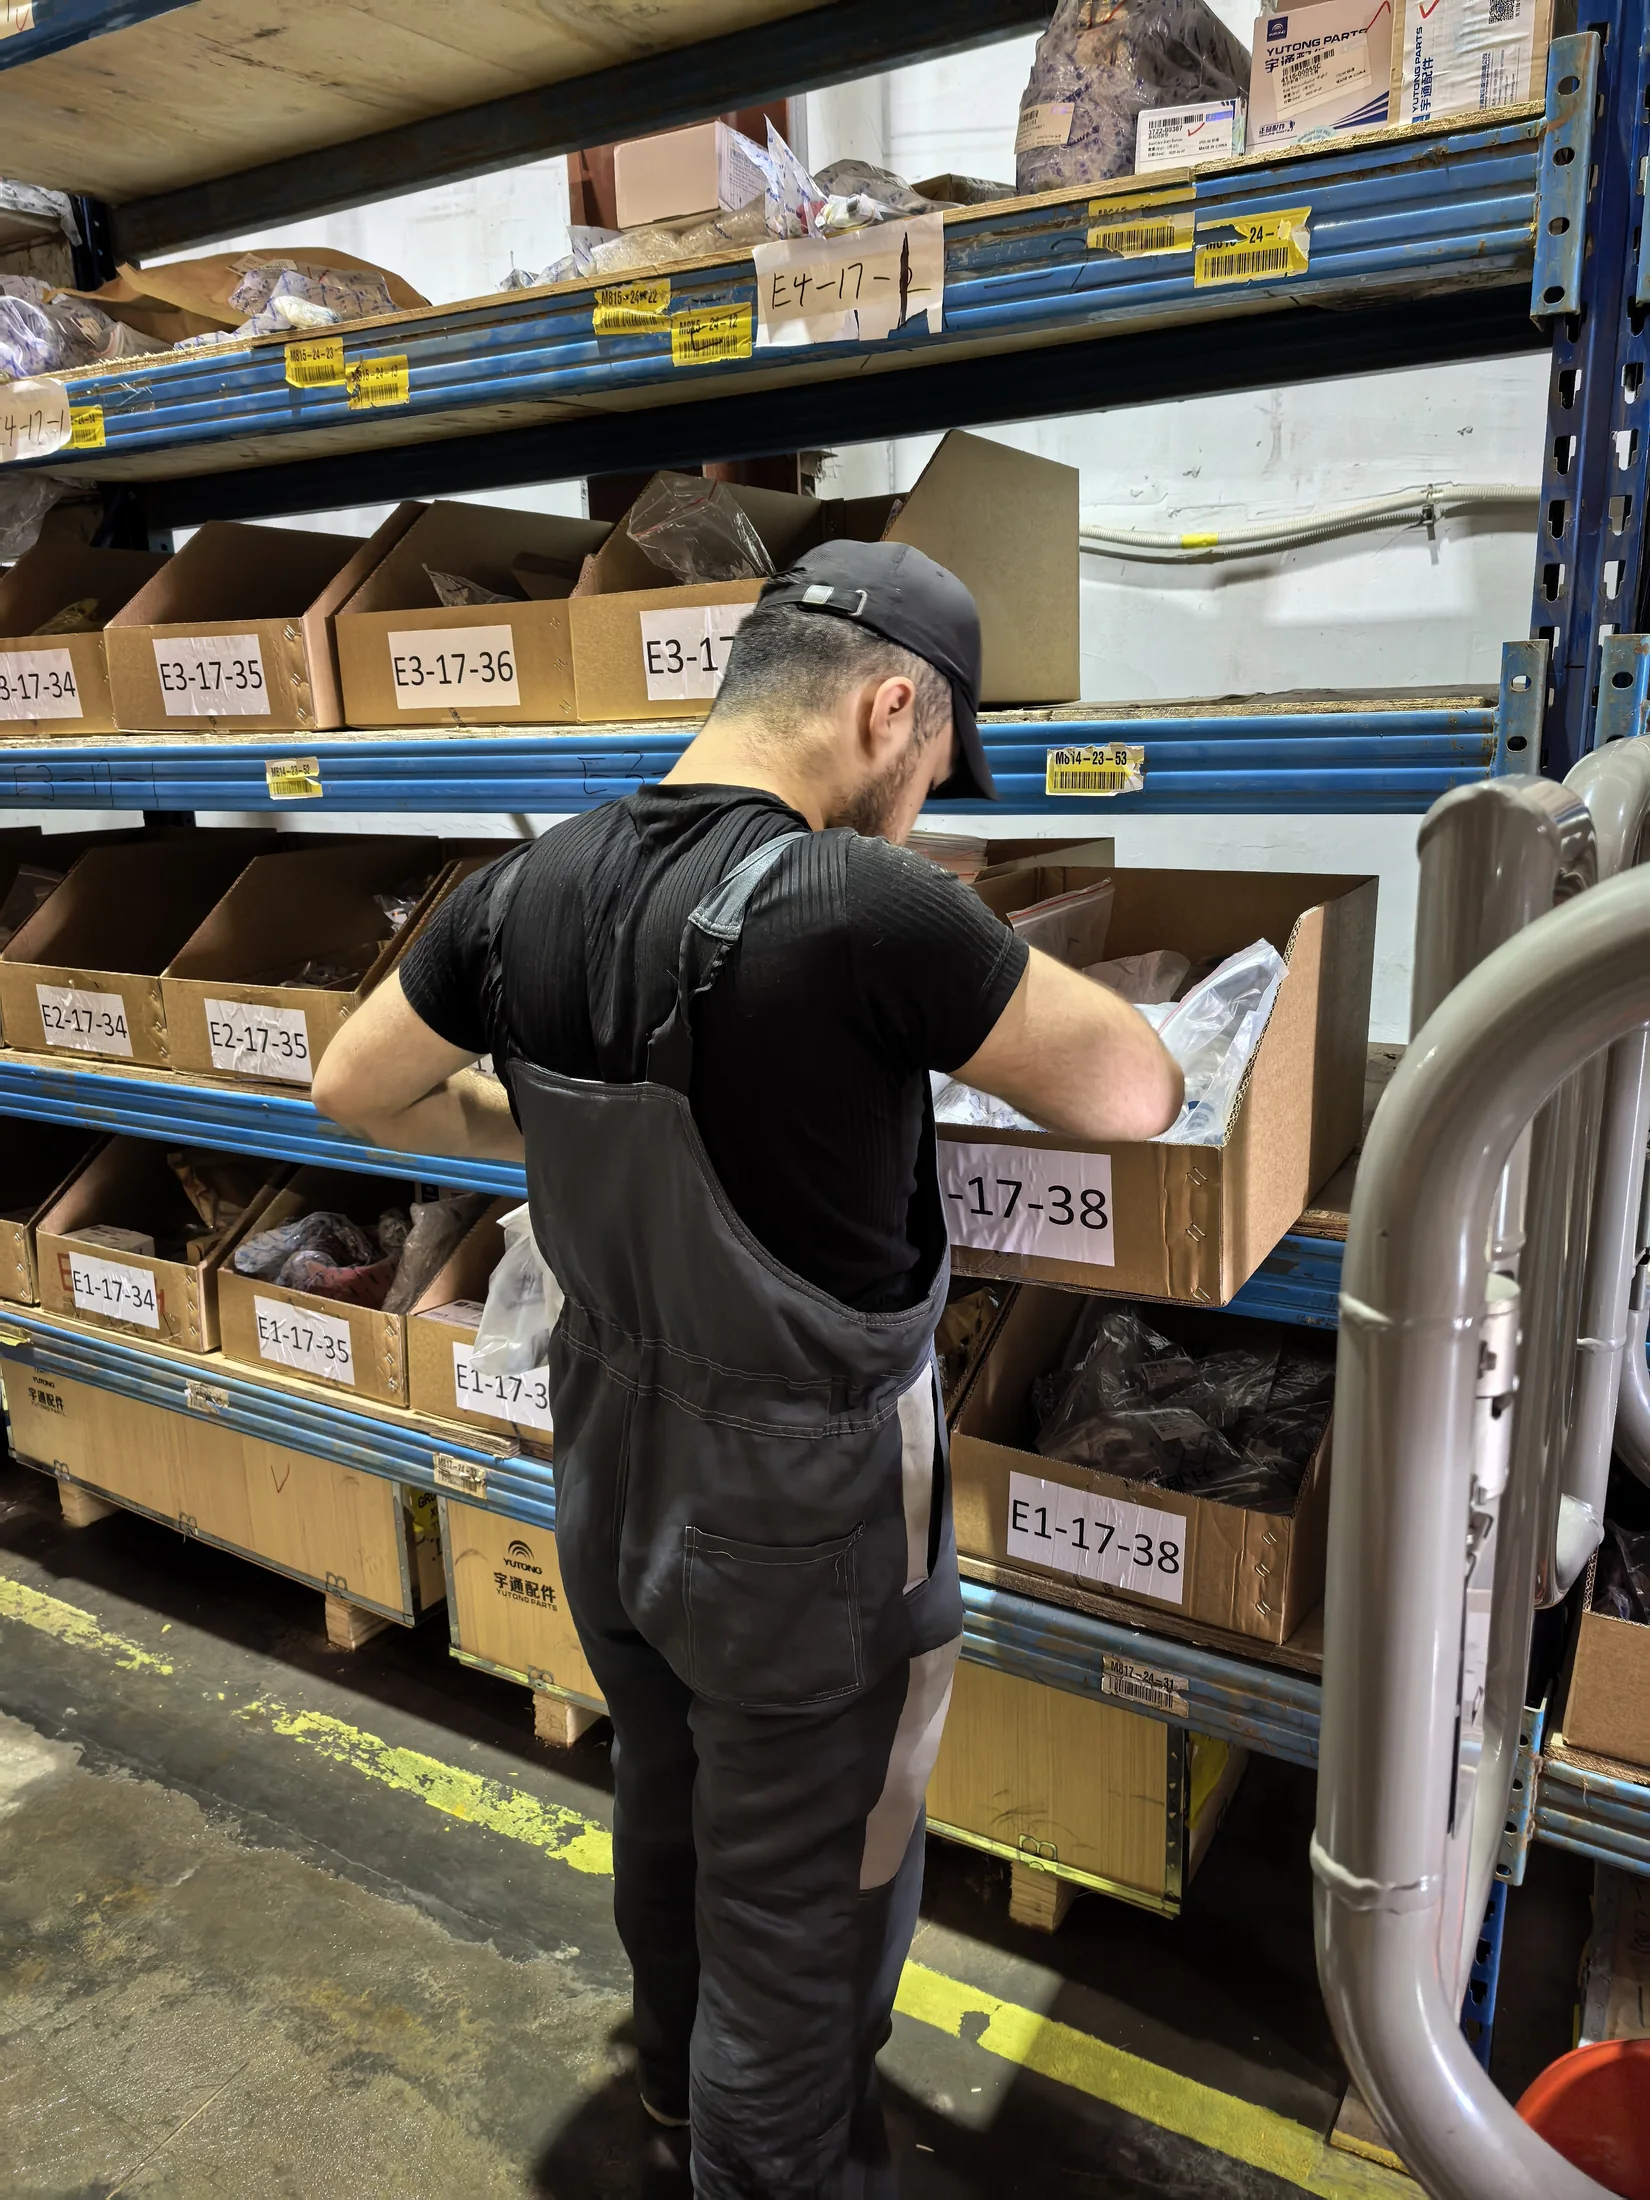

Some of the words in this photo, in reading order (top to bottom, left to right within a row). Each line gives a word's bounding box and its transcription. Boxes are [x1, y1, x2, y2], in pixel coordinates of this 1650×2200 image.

[1266, 38, 1321, 57] YUTONG
[1415, 26, 1423, 62] PARTS
[1412, 66, 1421, 113] YUTONG
[1420, 57, 1434, 112] 宇通配件
[160, 660, 263, 692] E3-17-35
[394, 650, 514, 687] E3-17-36
[41, 1004, 128, 1039] E2-17-34
[210, 1021, 308, 1059] E2-17-35
[73, 1270, 155, 1311] E1-17-34
[257, 1315, 350, 1364] E1-17-35
[1011, 1498, 1180, 1575] E1-17-38
[503, 1558, 543, 1575] YUTONG
[493, 1572, 557, 1604] 宇通配件
[496, 1587, 530, 1604] YUTONG
[530, 1597, 558, 1612] PARTS
